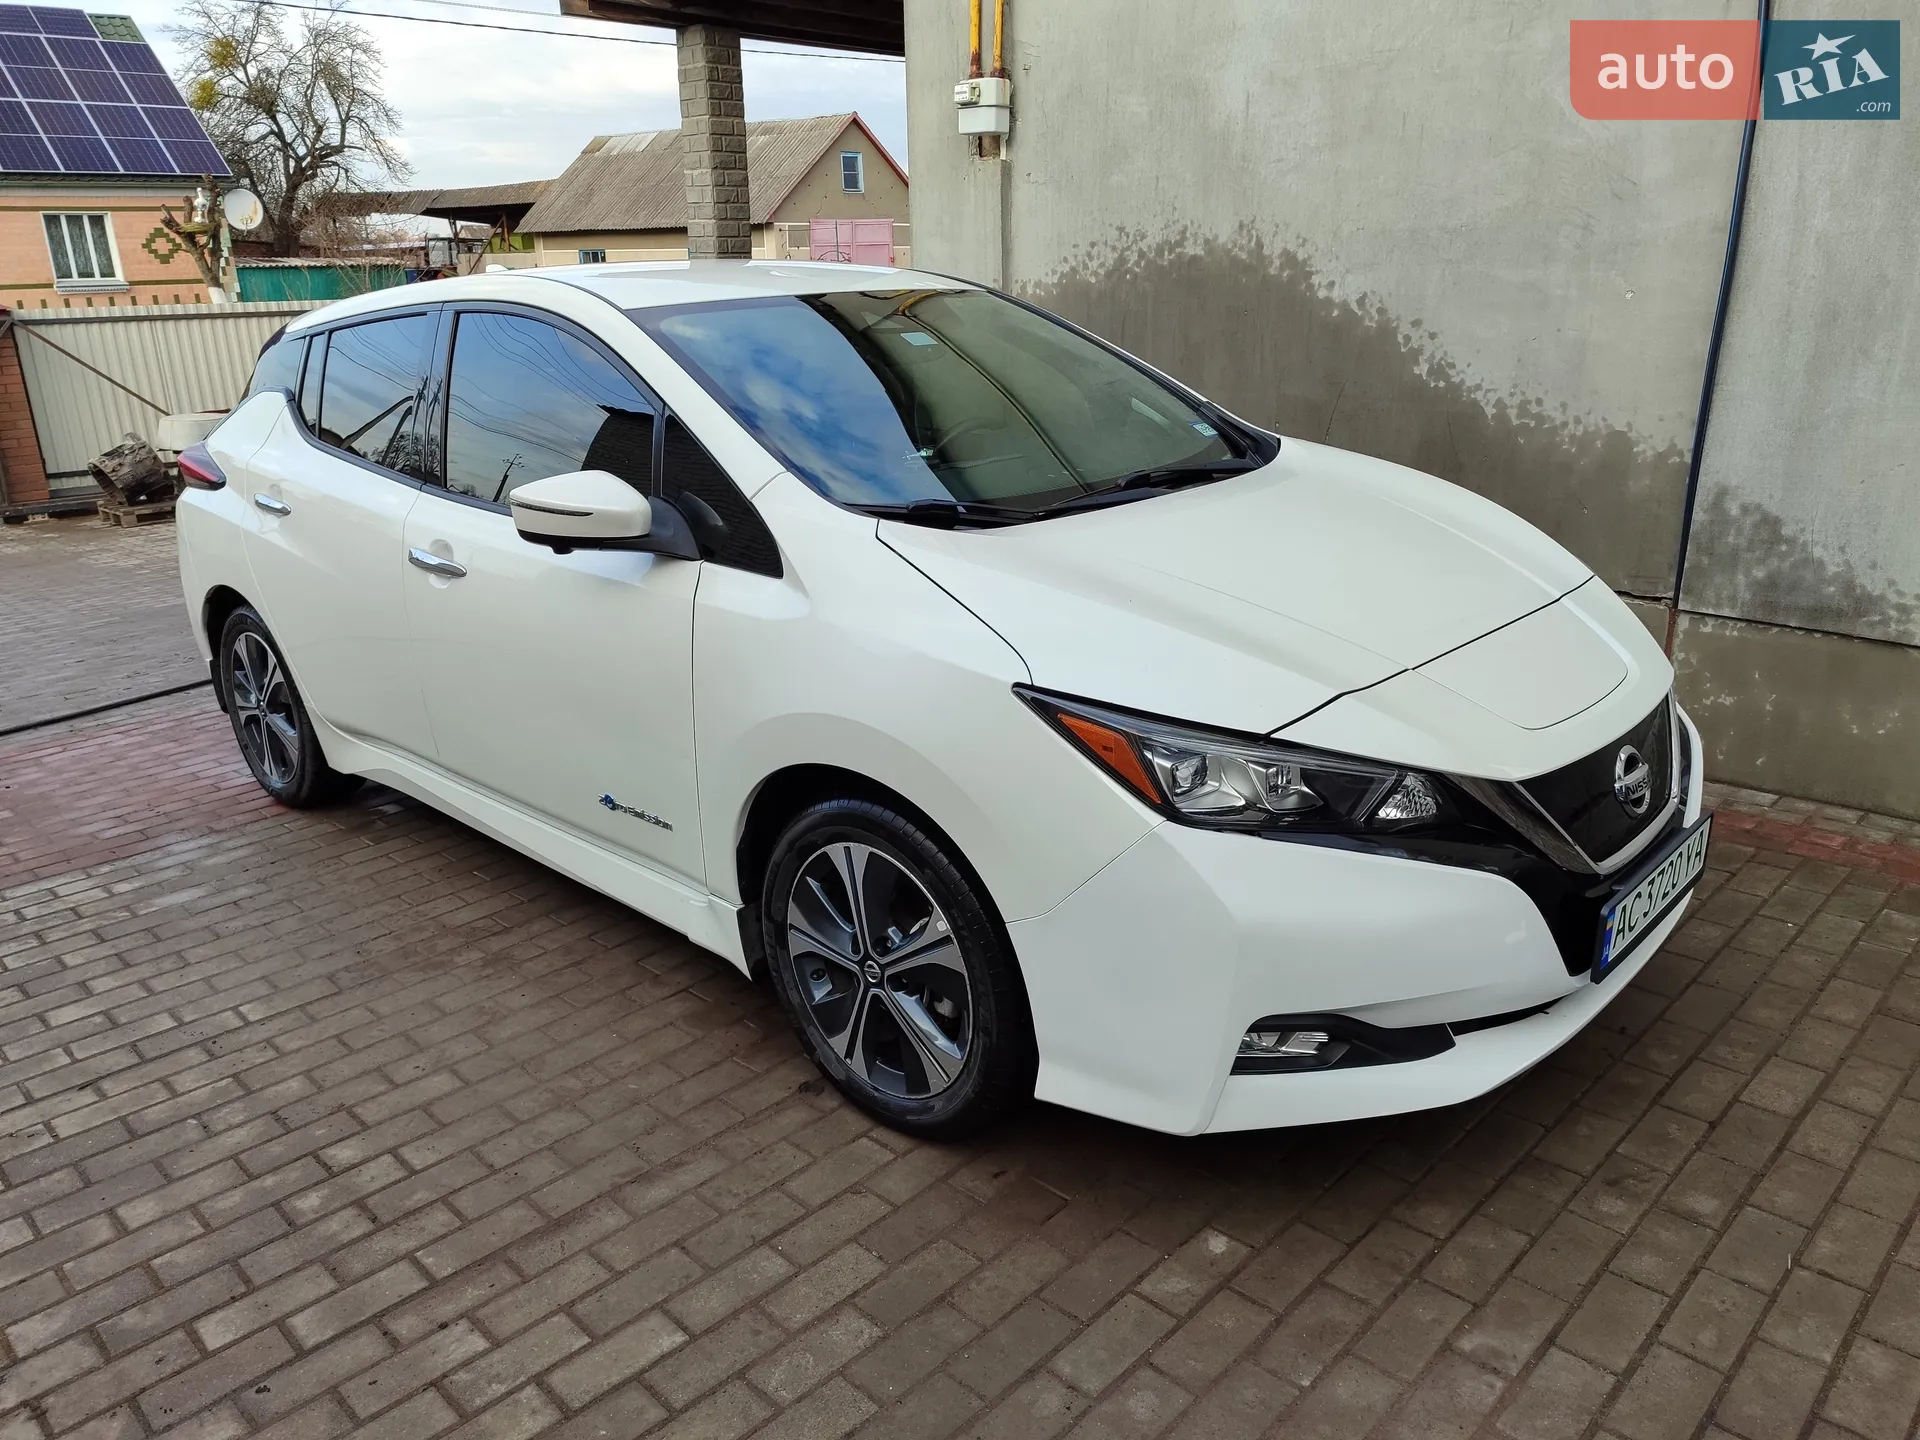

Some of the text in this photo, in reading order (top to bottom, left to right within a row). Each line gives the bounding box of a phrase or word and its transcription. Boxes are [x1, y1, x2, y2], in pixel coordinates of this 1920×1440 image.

[1612, 829, 1705, 950] AC 3720 YA
